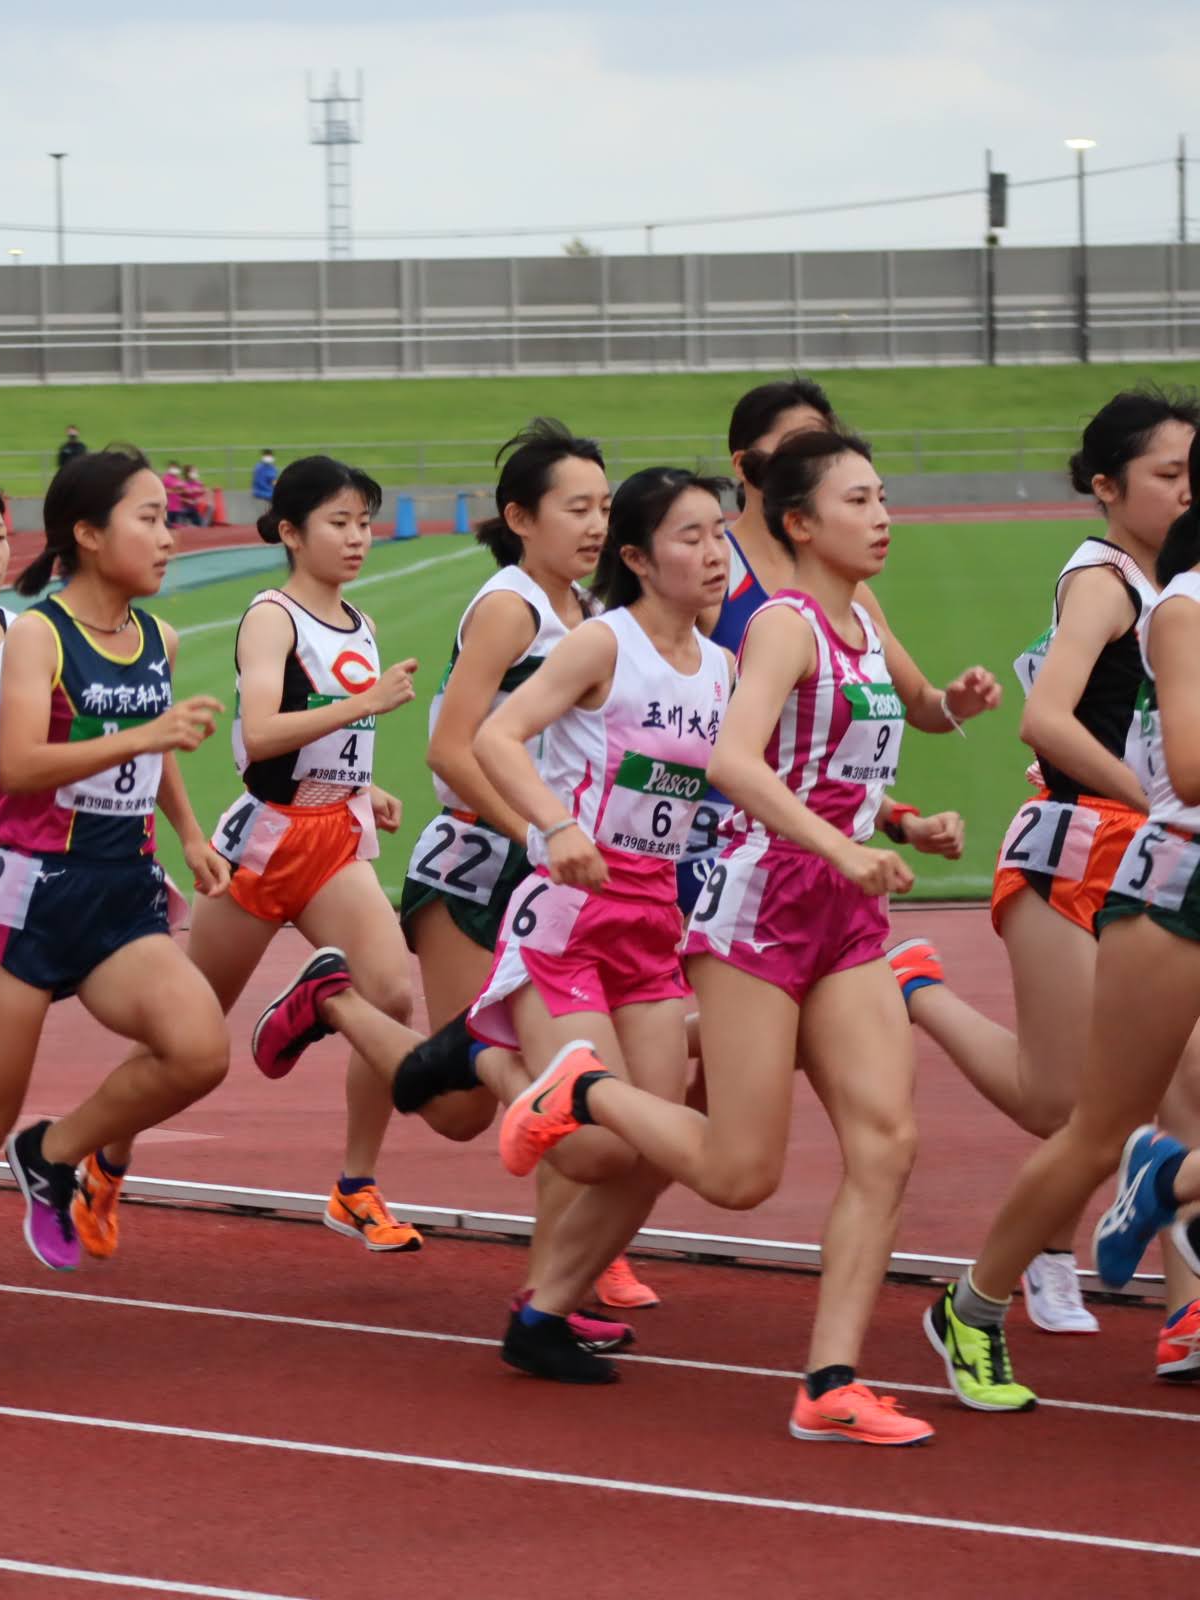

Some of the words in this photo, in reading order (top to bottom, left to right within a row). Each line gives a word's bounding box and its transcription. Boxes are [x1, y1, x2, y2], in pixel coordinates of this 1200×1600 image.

[331, 651, 378, 694] C
[339, 734, 358, 767] 4
[873, 724, 891, 763] 9
[115, 758, 137, 795] 8
[643, 761, 700, 798] Pasco
[222, 802, 256, 852] 4
[651, 800, 673, 838] 6
[1005, 806, 1073, 868] 21
[416, 822, 493, 894] 22
[1129, 830, 1166, 890] 5
[512, 882, 550, 939] 6
[694, 864, 728, 923] 9
